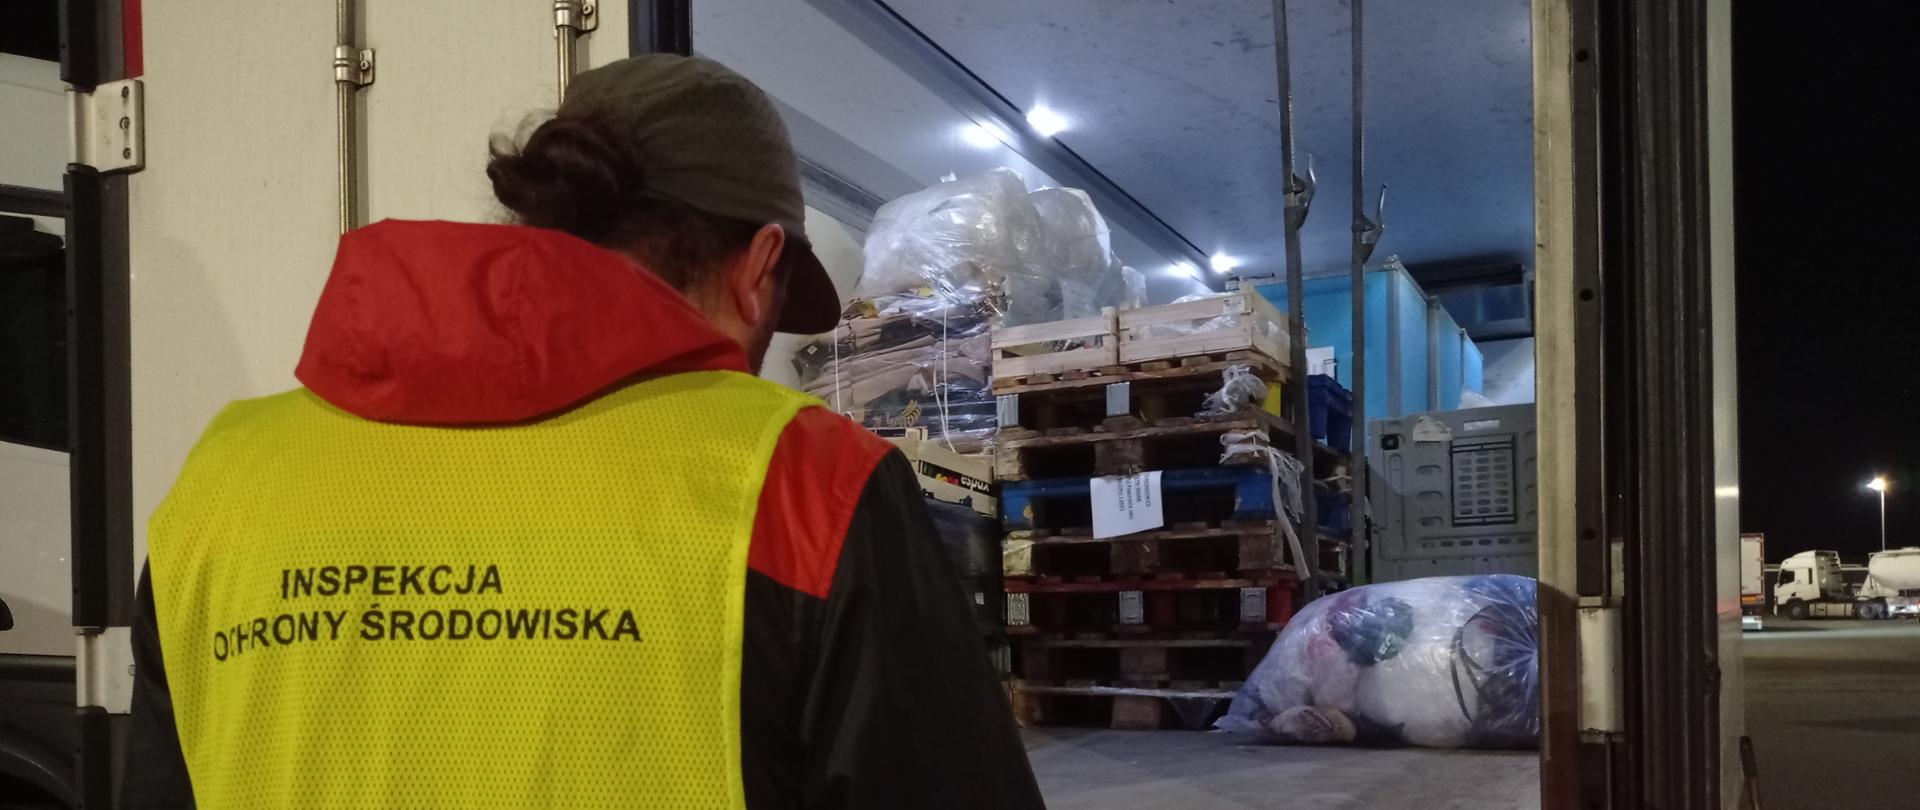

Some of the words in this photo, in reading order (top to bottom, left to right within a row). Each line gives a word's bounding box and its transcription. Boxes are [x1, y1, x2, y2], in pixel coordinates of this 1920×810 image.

[281, 564, 503, 599] INSPEKCJA
[213, 609, 348, 661] OCHRONY
[359, 603, 643, 642] ŚRODOWISKA
